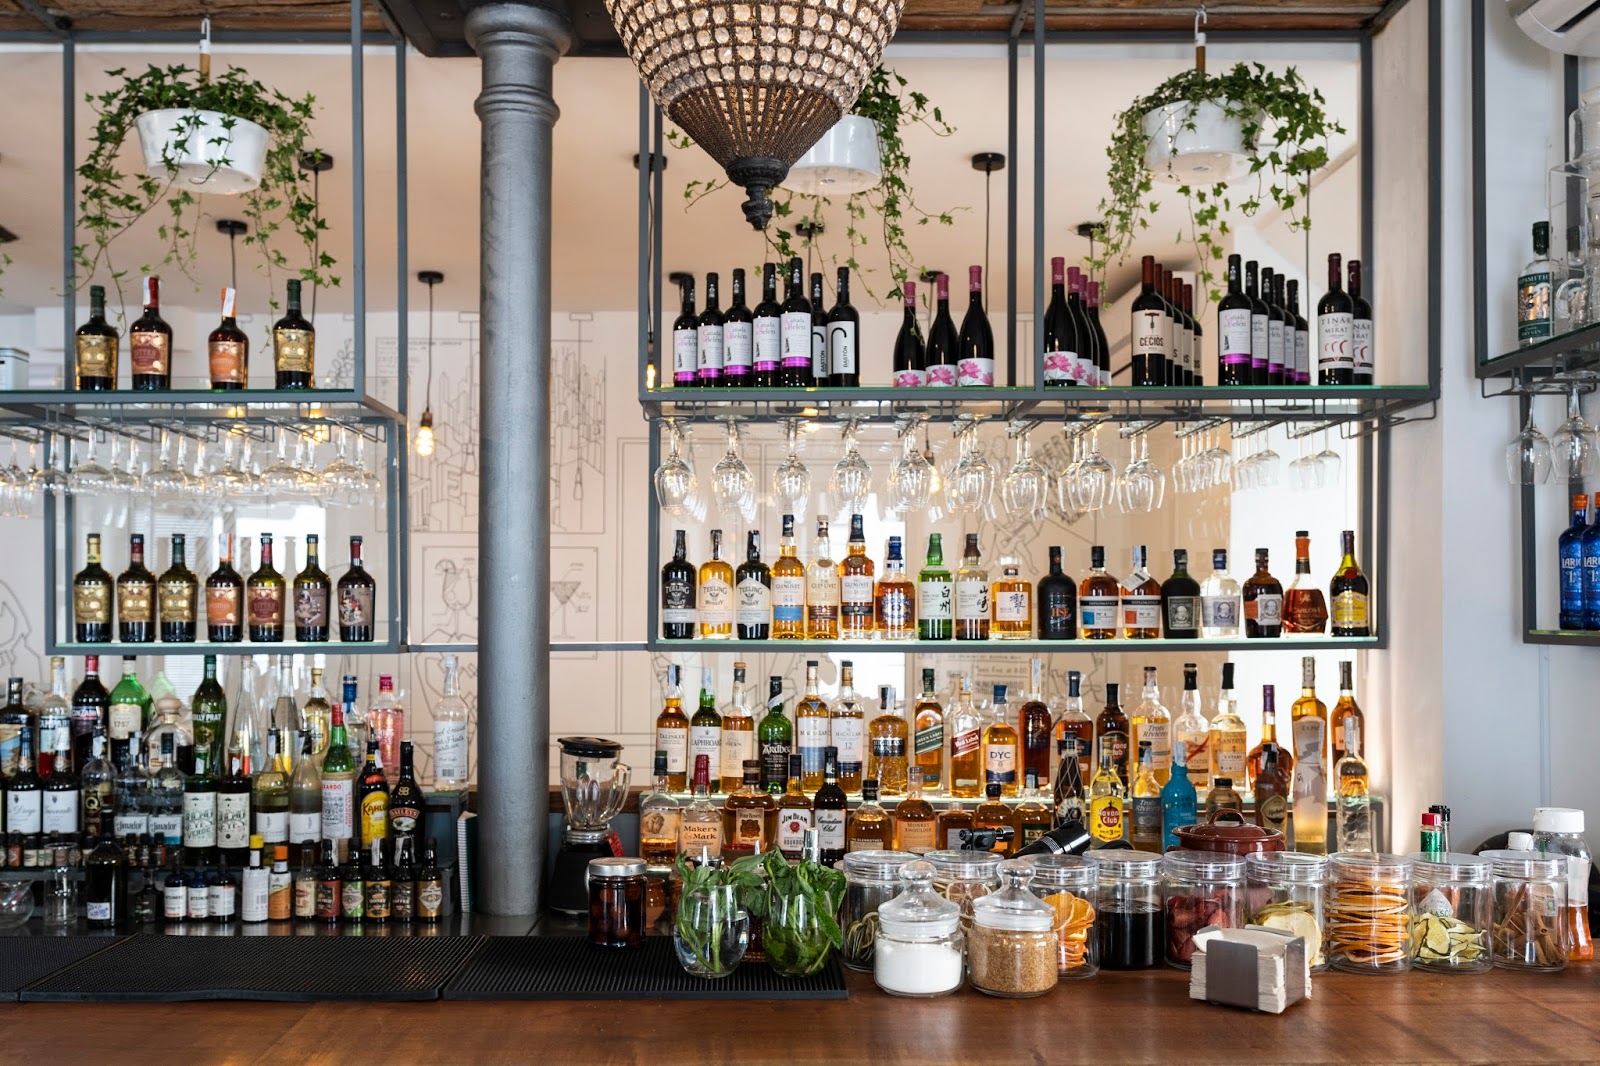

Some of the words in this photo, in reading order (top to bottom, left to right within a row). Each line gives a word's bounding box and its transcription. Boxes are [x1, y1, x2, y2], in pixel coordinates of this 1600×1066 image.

[665, 585, 690, 595] TEELING
[703, 586, 728, 595] TEELING
[739, 586, 763, 595] TEELING
[666, 598, 687, 607] WHISKEY
[1052, 607, 1070, 618] HSE
[206, 713, 222, 721] PRAT
[844, 741, 853, 750] 12
[990, 751, 1011, 759] DYC
[389, 807, 420, 818] BAILEYS
[781, 814, 792, 824] JIM
[792, 812, 808, 824] BEAM
[817, 815, 843, 825] Canadian
[1102, 816, 1118, 824] Club
[683, 825, 718, 833] Maker's
[821, 824, 837, 833] Club
[693, 832, 717, 840] Mark
